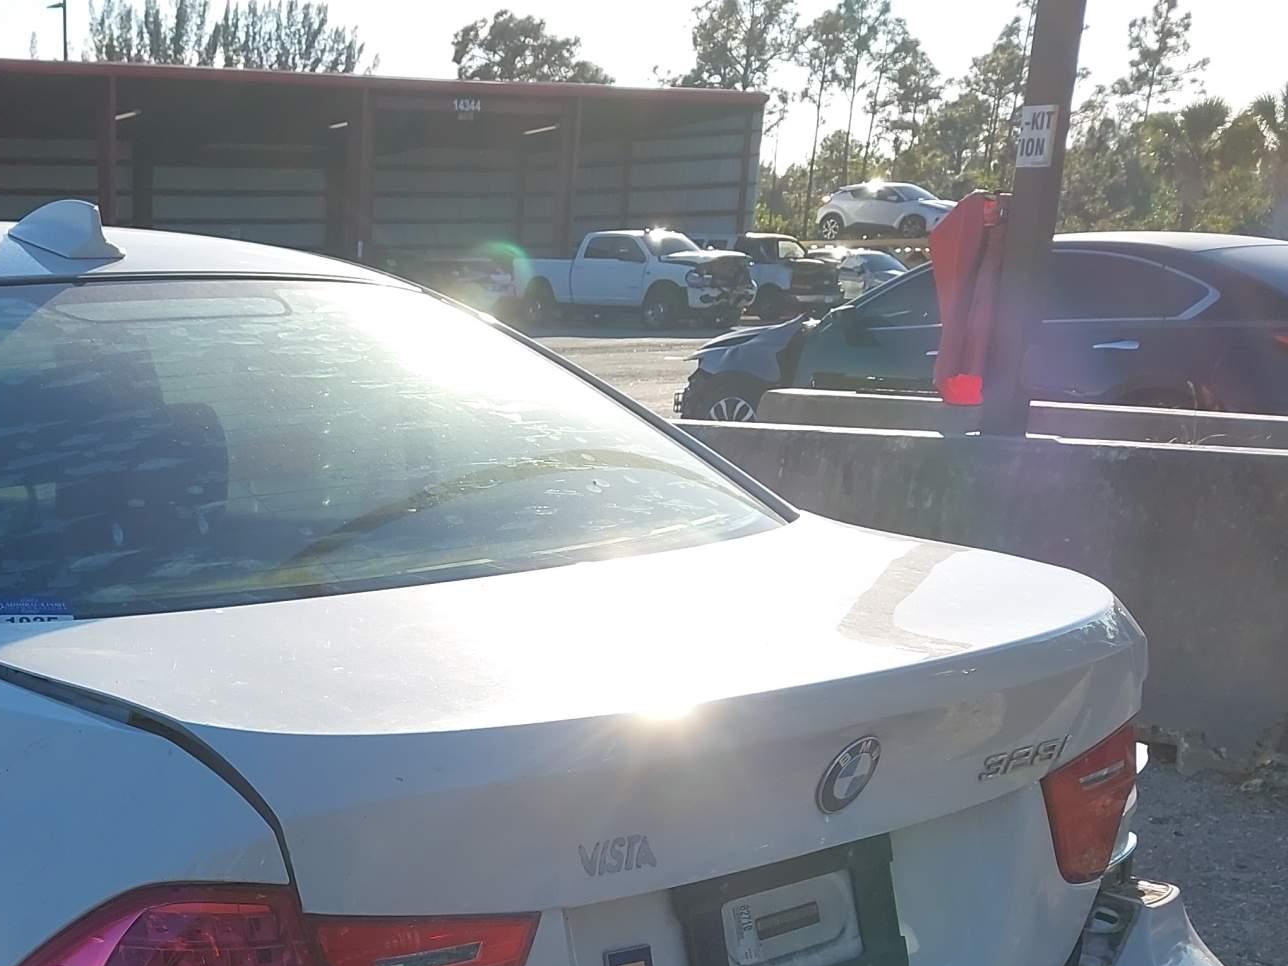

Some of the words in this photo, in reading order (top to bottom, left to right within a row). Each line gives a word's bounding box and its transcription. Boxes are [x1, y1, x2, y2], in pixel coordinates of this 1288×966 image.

[453, 99, 481, 111] 14344
[1020, 111, 1055, 131] -KIT
[1017, 137, 1046, 157] ION
[578, 834, 657, 877] VISTA
